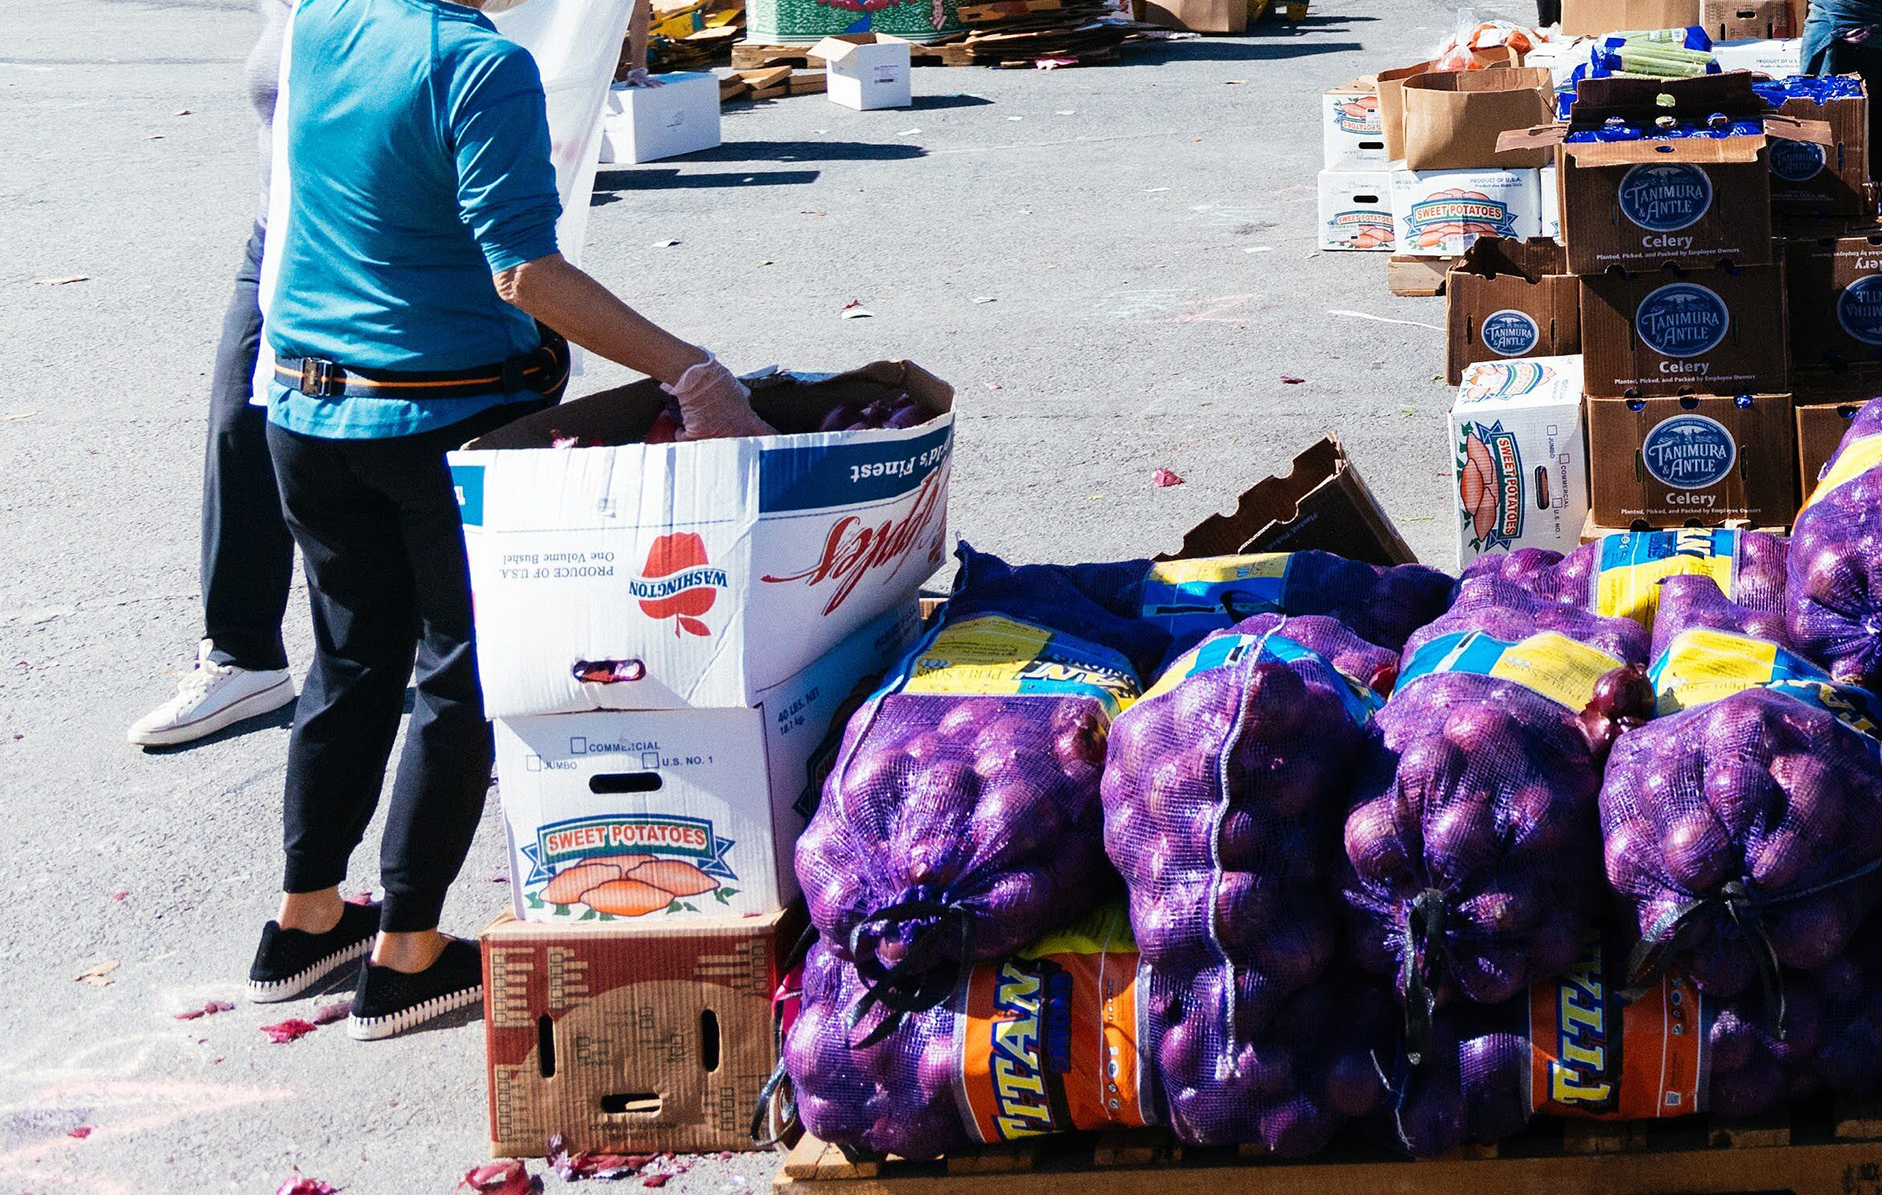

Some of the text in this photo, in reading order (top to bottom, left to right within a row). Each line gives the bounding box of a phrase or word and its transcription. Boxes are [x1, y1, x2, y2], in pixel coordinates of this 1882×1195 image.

[1624, 182, 1703, 209] TANIMURA
[1338, 215, 1358, 224] SWEET
[1417, 205, 1501, 220] SWEET POTATOES
[1638, 199, 1692, 224] & ANTLE
[1642, 235, 1693, 250] Celery
[1622, 252, 1643, 260] Picked,
[1657, 249, 1678, 257] Packed
[1679, 249, 1687, 257] by
[1641, 311, 1719, 335] TANIMURA
[1485, 326, 1532, 342] TANIMURA
[1656, 327, 1709, 349] & ANTLE
[1495, 336, 1525, 349] ANTLE
[1659, 361, 1709, 375] Celery
[1696, 375, 1703, 383] by
[1548, 437, 1556, 459] JUMBO
[1649, 443, 1727, 466] TANIMURA
[850, 455, 915, 483] Finest
[1662, 464, 1670, 473] &
[1665, 458, 1715, 479] ANTLE
[1498, 438, 1519, 535] SWEET POTATOES
[1560, 465, 1570, 509] COMMERCIAL
[1666, 492, 1717, 506] Celery
[503, 552, 615, 565] One Volume Bushel
[499, 566, 614, 579] PRODUCE OF U.S.A.
[629, 570, 728, 598] WASHINGTON
[916, 667, 1002, 680] PERI SONS
[778, 686, 820, 723] 40 LBS. NET
[779, 720, 793, 736] 18.1
[544, 756, 713, 770] JUMBO U.S. NO. 1
[548, 824, 706, 852] SWEET POTATOES
[994, 961, 1052, 1141] TITAN
